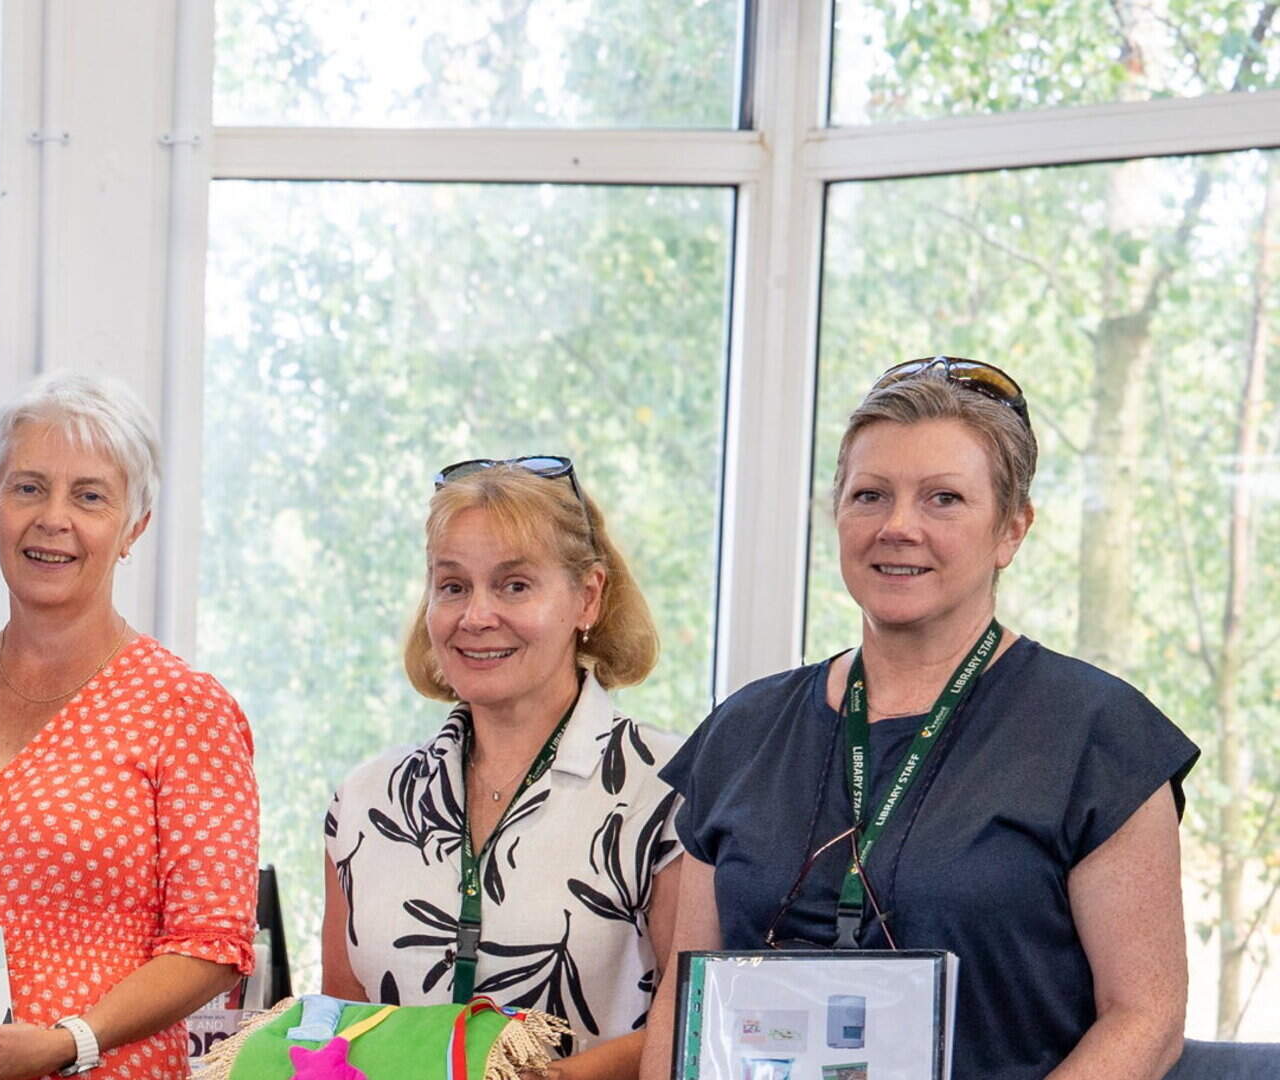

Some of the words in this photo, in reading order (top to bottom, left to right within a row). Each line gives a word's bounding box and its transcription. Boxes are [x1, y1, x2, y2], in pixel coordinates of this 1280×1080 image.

[951, 658, 982, 695] LIBRARY
[977, 629, 998, 664] STAFF
[852, 746, 863, 790] LIBRARY
[875, 783, 904, 827] LIBRARY
[899, 753, 921, 787] STAFF
